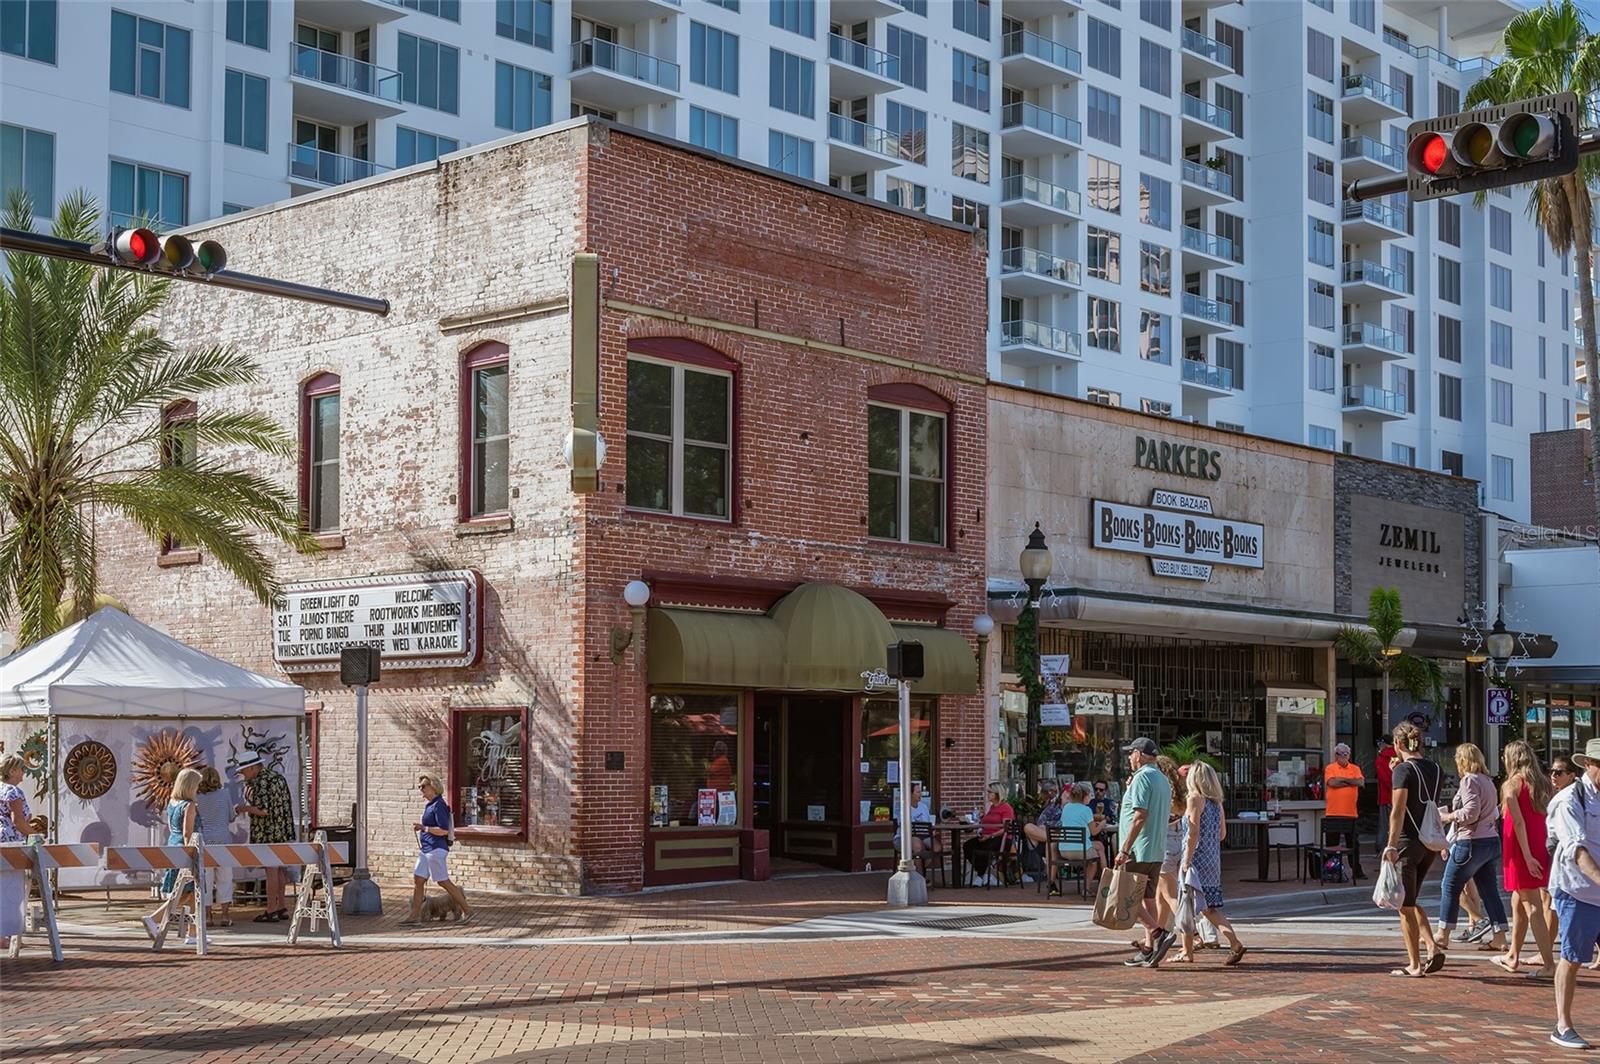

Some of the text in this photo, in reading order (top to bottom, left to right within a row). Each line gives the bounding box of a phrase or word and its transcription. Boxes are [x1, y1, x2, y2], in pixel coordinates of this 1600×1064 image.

[1135, 436, 1222, 481] PARKERS
[1156, 493, 1209, 511] BOOK BAZAAR
[1380, 523, 1440, 554] ZEMIL
[1379, 557, 1439, 574] JEWELERS
[300, 597, 323, 610] GREEN
[324, 595, 345, 608] LIGHT
[349, 594, 360, 606] GO
[395, 589, 433, 603] WELCOME
[278, 610, 355, 627] SAT ALMOST THERE
[370, 603, 461, 620] ROOTWORKS MEMBERS
[278, 626, 349, 641] TUE PORNO BINGO
[364, 619, 458, 637] THUR JAH MOVEMENT
[278, 643, 310, 657] WHISKEY
[317, 640, 343, 655] CIGARS
[392, 635, 458, 651] WED KARAOKE
[1491, 690, 1508, 698] PAY
[1496, 700, 1505, 713] P
